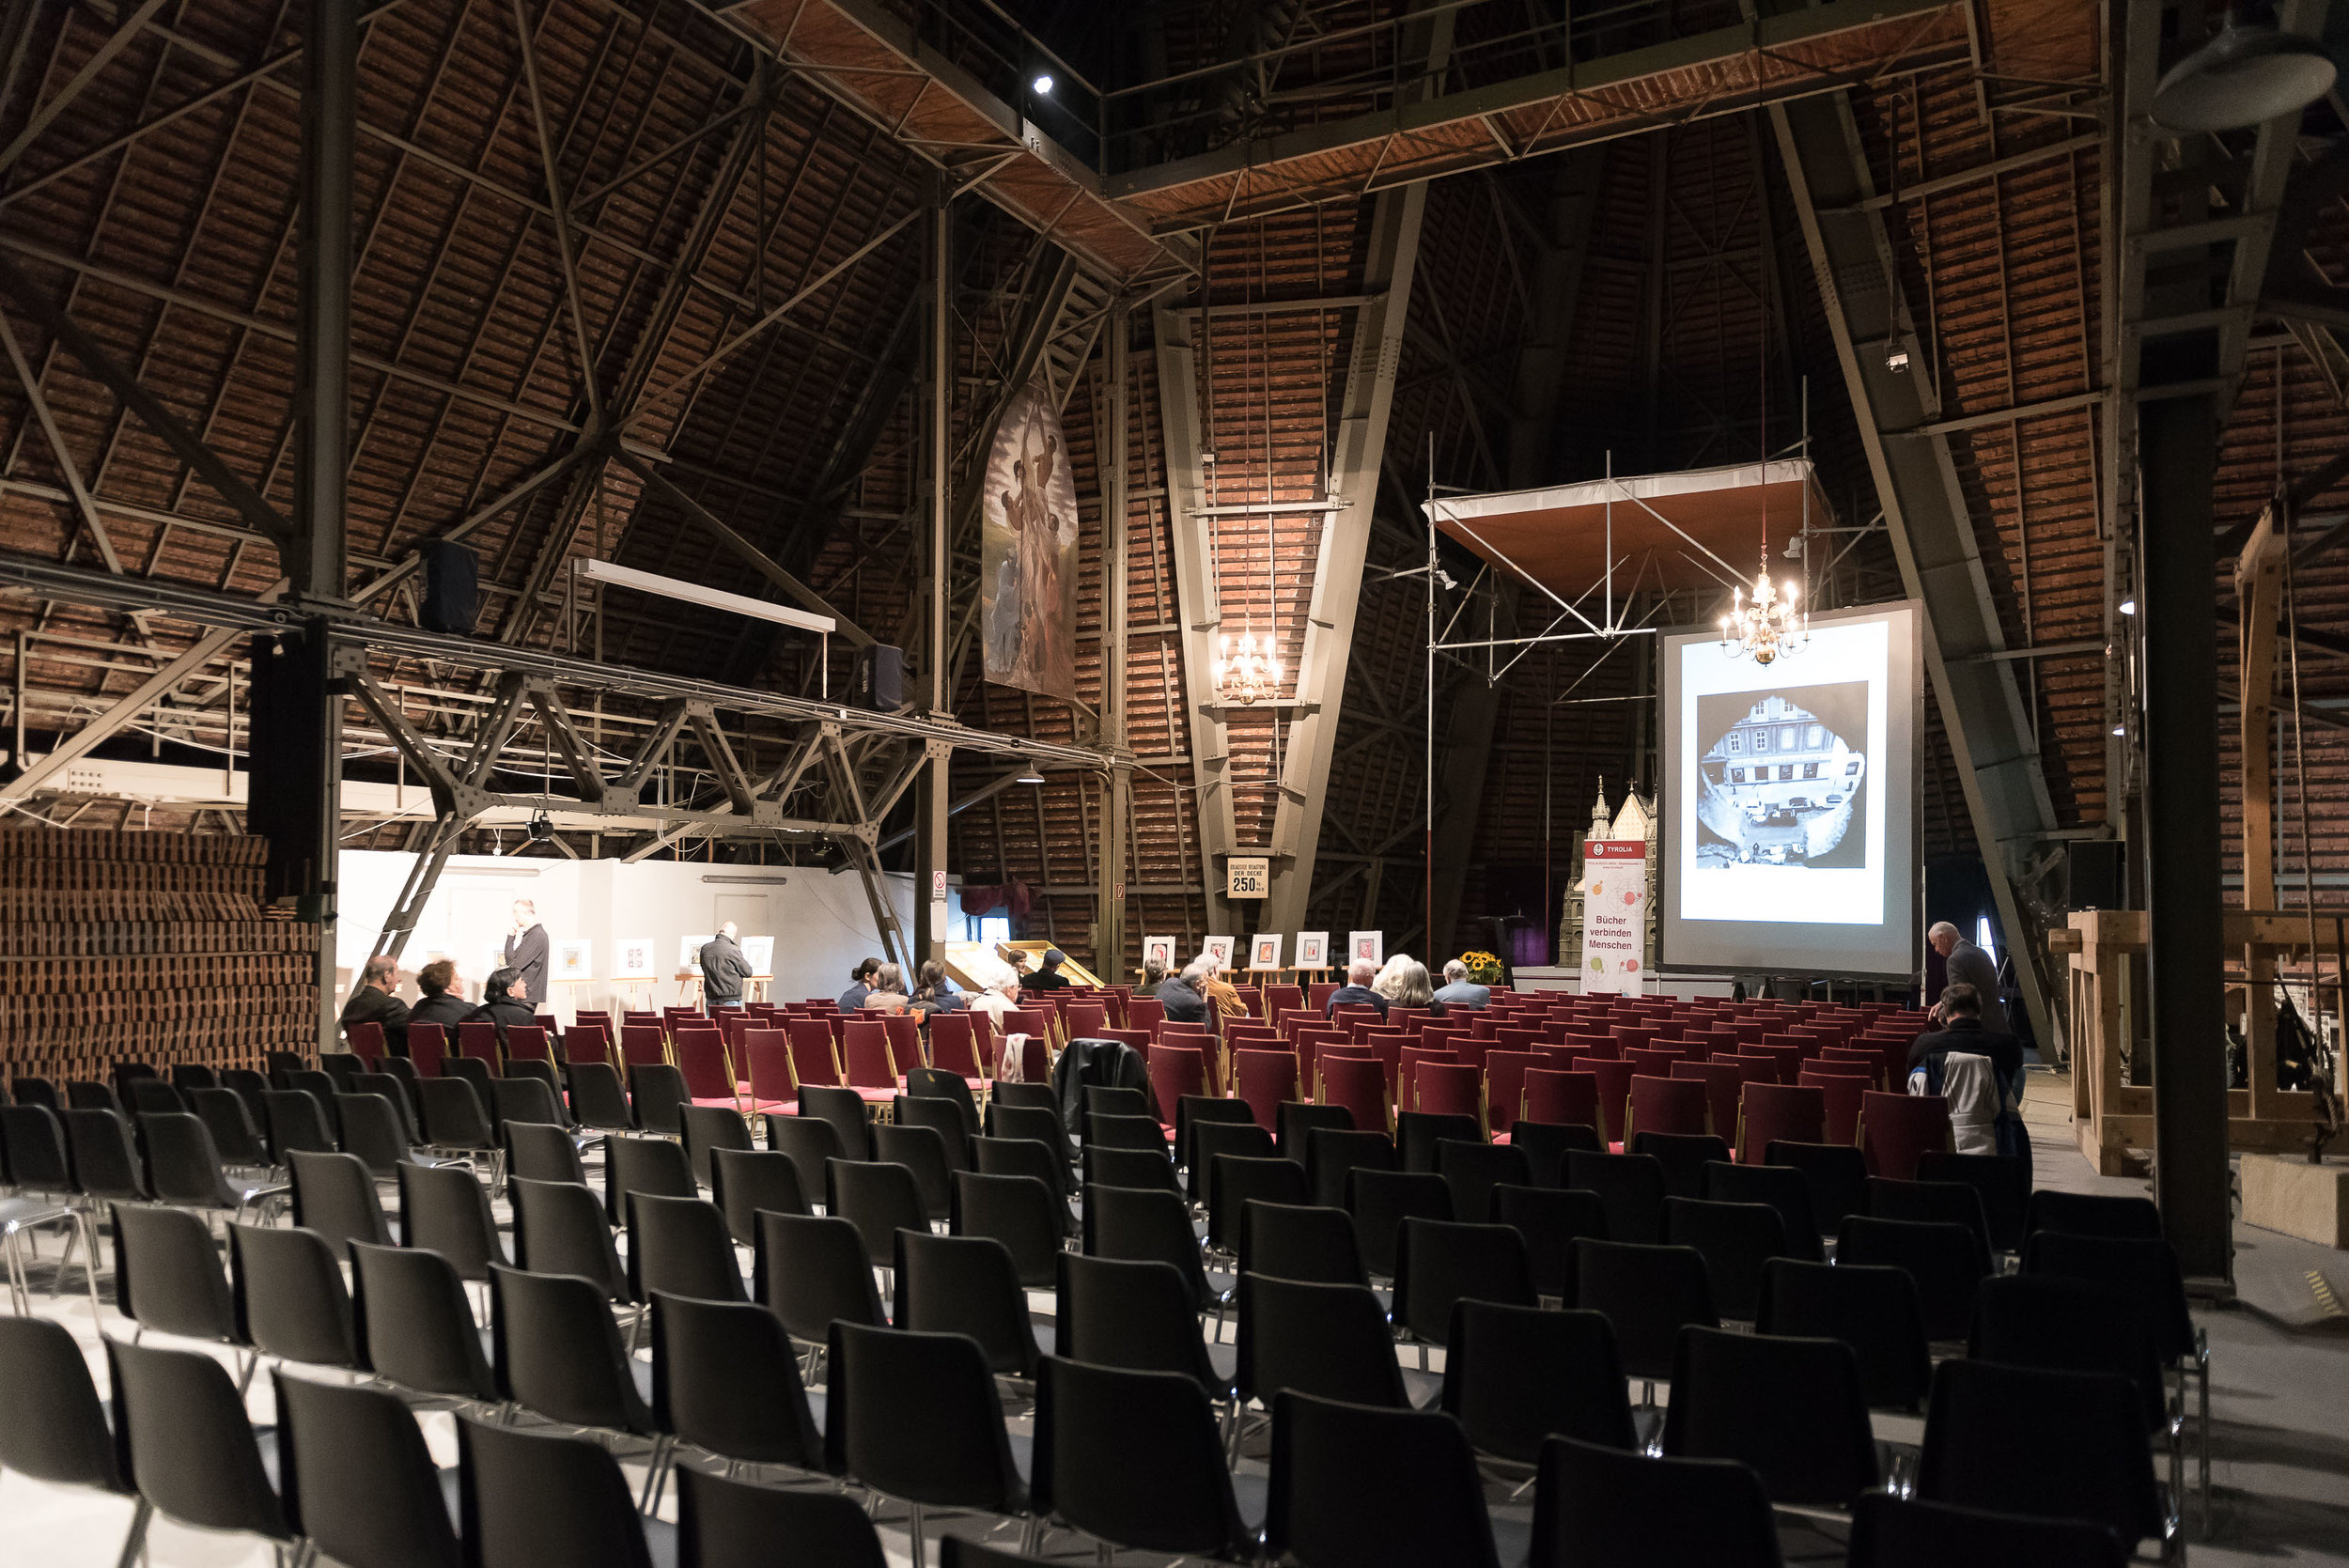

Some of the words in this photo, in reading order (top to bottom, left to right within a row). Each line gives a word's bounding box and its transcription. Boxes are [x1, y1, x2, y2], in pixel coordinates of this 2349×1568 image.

[1234, 877, 1255, 892] 250
[1595, 915, 1626, 925] Bücher
[1590, 928, 1632, 938] verbinden
[1589, 939, 1632, 950] Menschen
